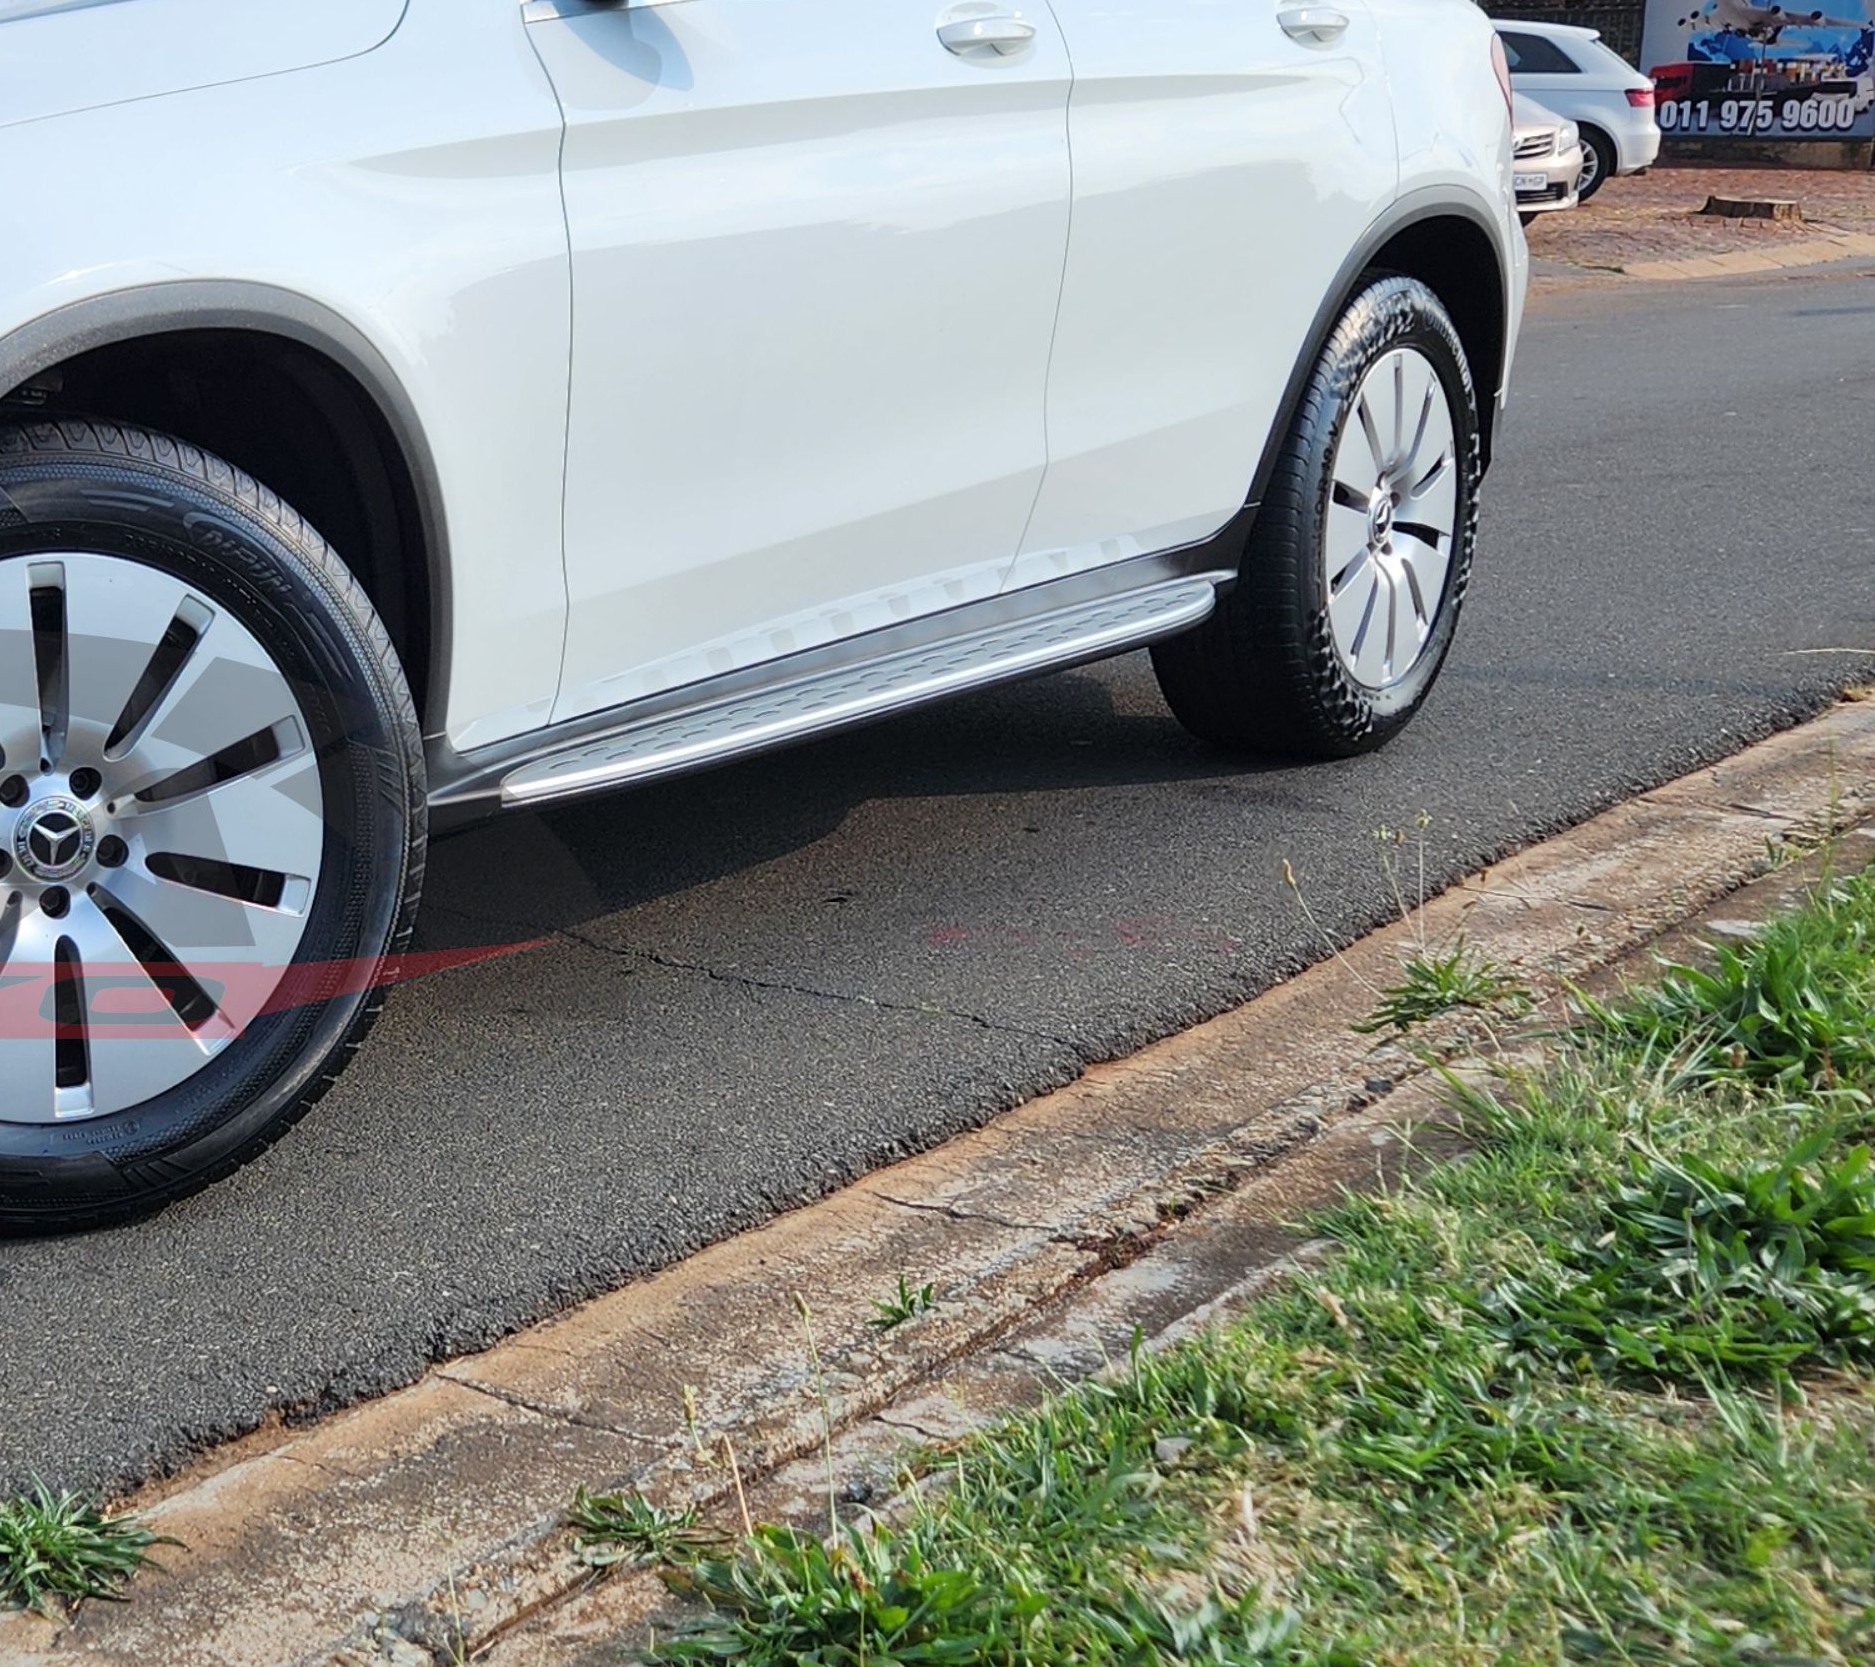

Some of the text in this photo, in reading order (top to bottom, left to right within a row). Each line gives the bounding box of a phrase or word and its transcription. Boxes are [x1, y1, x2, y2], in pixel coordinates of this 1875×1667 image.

[1659, 98, 1855, 131] 011 975 9600
